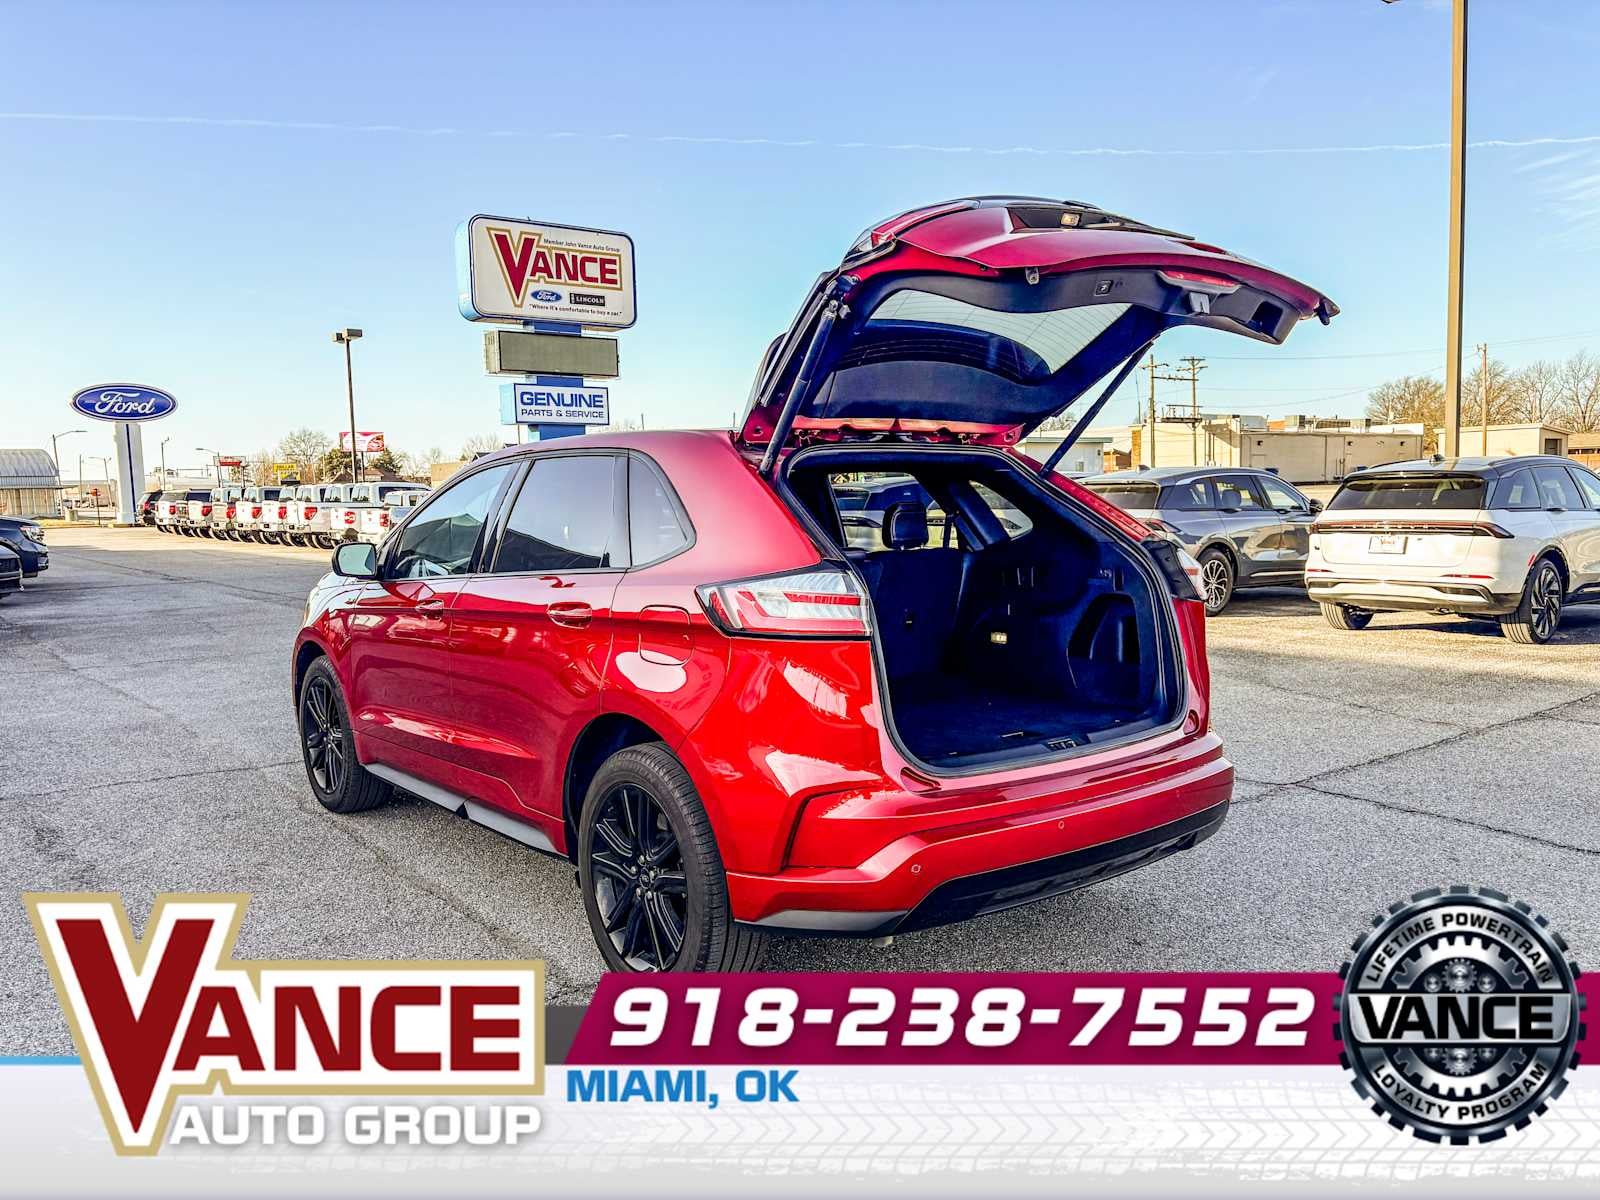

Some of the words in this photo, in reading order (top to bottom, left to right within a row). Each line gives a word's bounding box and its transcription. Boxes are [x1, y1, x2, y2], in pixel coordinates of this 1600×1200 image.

[494, 233, 618, 300] VANCE
[576, 296, 605, 304] LINCOLN
[95, 391, 155, 413] Ford
[520, 391, 604, 408] GENUINE
[521, 408, 553, 417] PARTS
[565, 409, 604, 418] SERVICE
